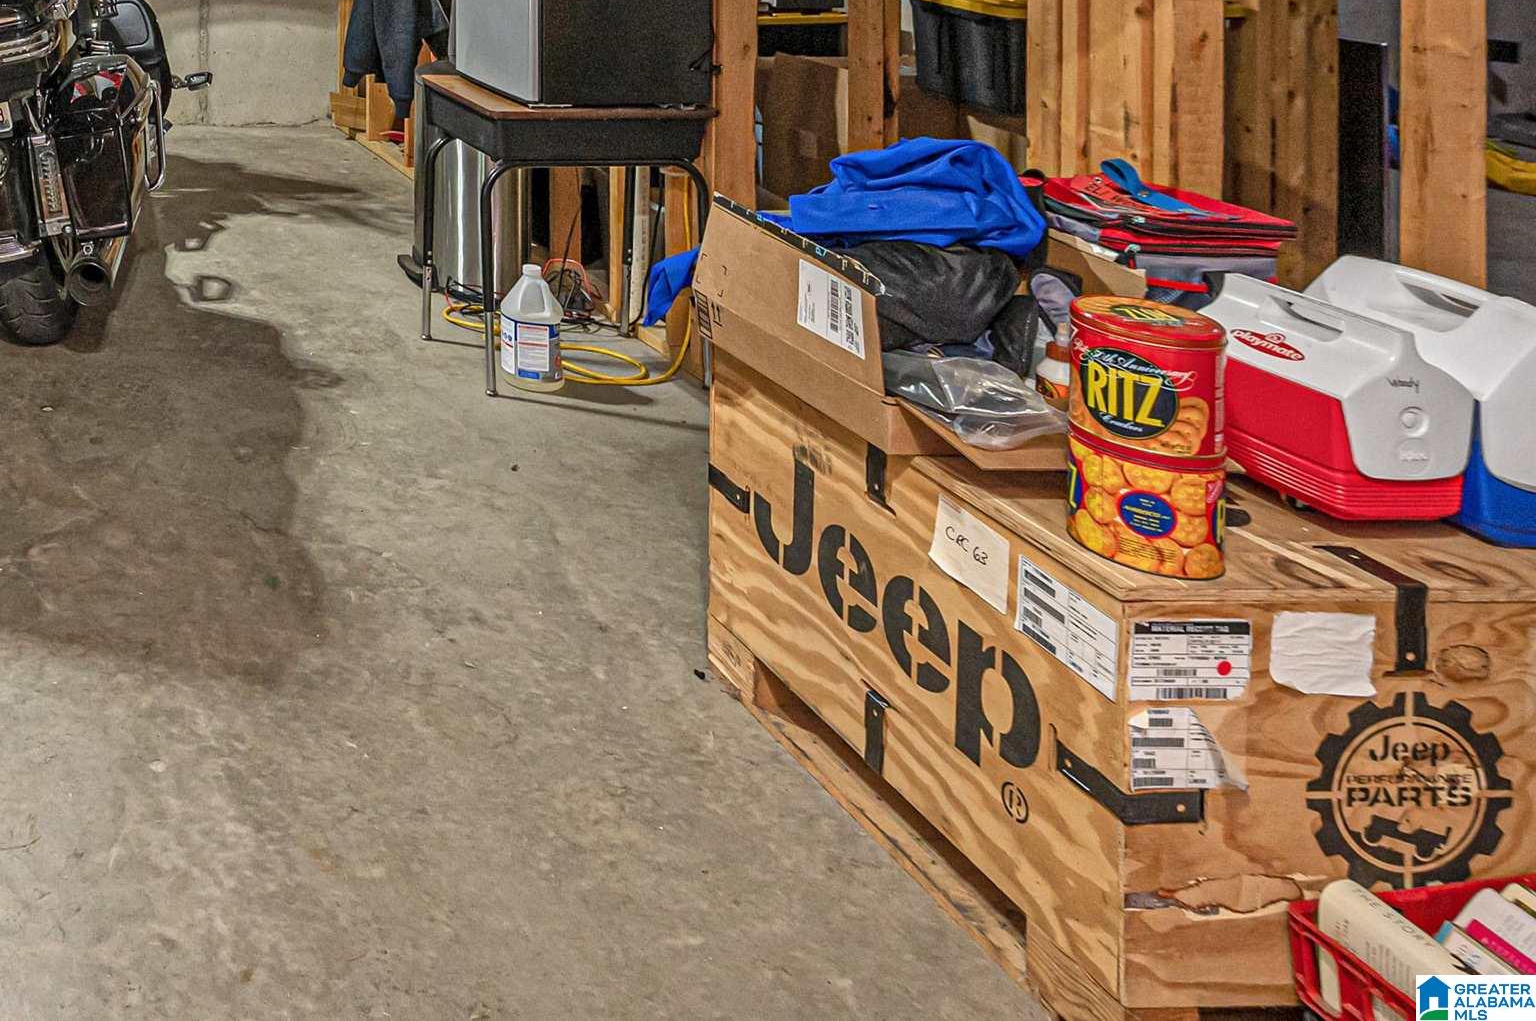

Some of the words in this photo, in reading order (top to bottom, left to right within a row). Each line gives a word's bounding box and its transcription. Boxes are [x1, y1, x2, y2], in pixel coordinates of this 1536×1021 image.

[1231, 330, 1305, 361] playmate
[1086, 359, 1167, 428] RITZ
[752, 456, 1042, 769] Jeep
[1151, 625, 1185, 633] MATERIAL
[1369, 734, 1451, 767] Jeep
[1345, 784, 1473, 808] PARTS
